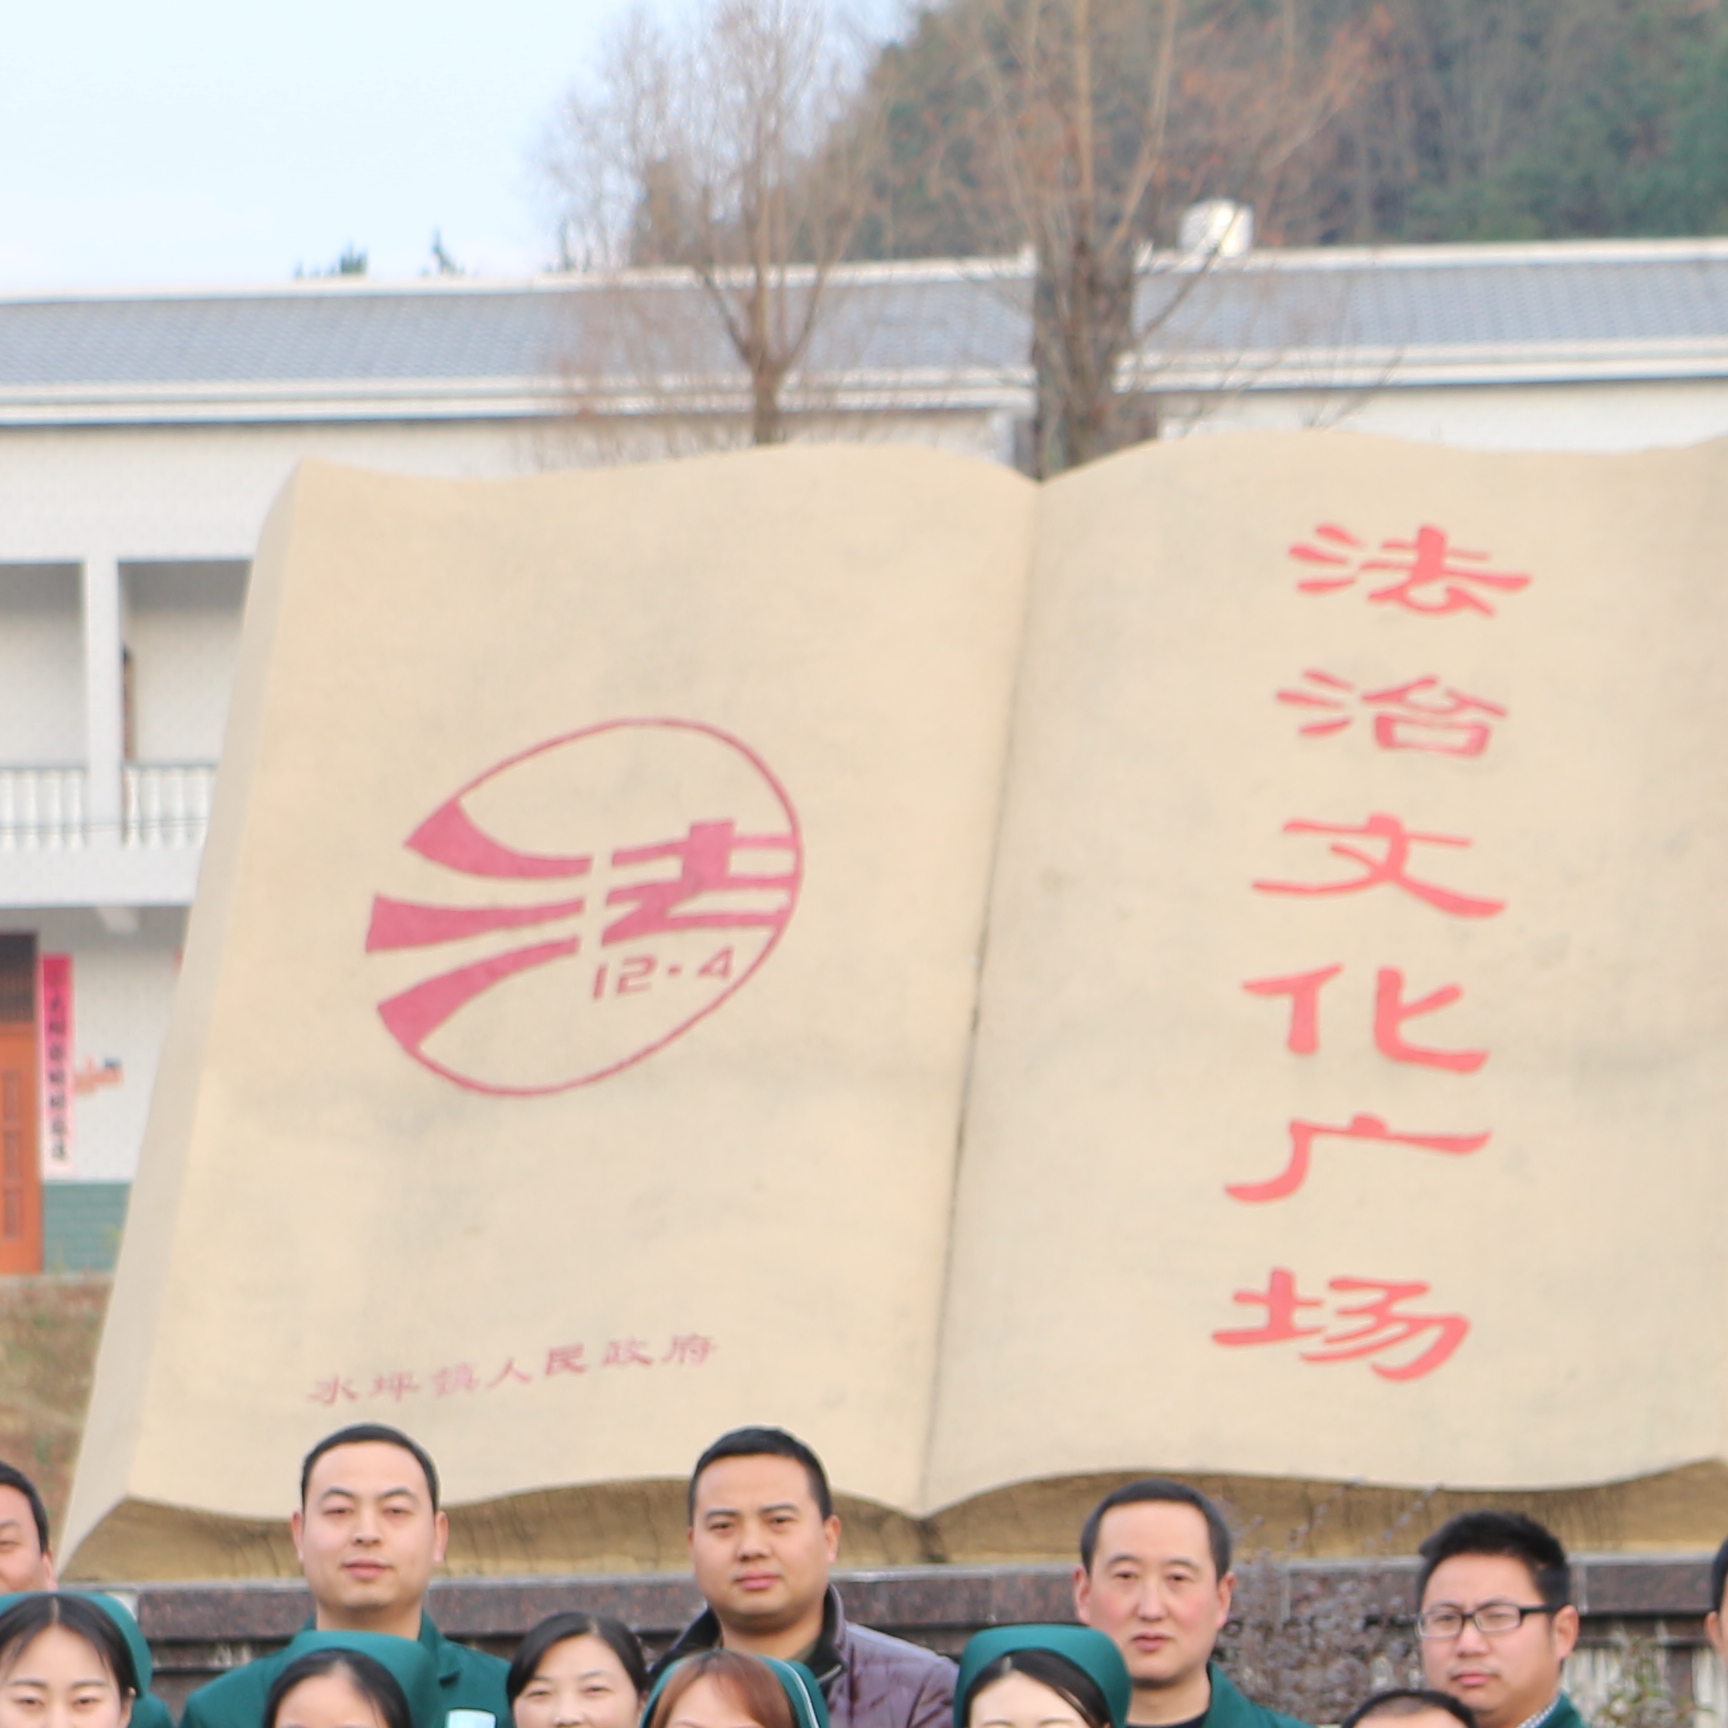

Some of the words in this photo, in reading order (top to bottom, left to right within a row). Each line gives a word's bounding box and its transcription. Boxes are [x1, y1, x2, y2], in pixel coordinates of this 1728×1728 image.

[1212, 522, 1534, 1384] 法治文化广场
[307, 1332, 718, 1405] 水坪镇人民政府
